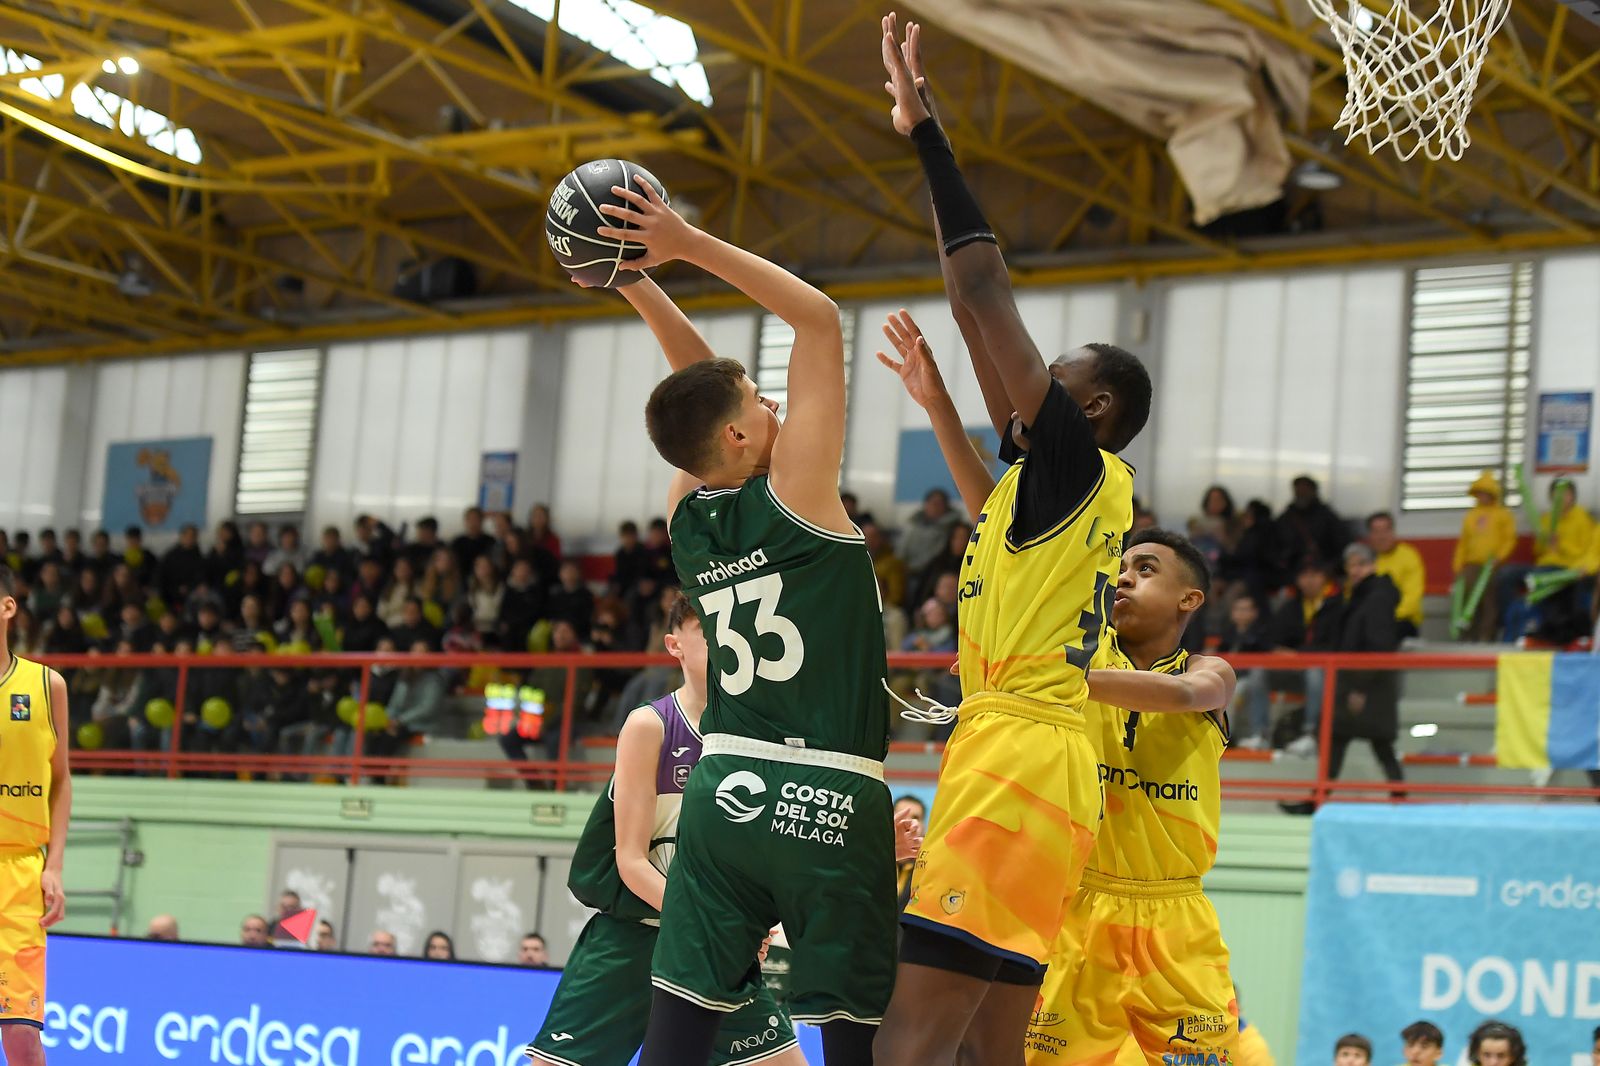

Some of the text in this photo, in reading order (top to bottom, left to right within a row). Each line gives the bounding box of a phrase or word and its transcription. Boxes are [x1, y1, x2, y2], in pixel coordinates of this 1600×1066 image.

[546, 229, 572, 257] SPA
[698, 572, 805, 696] 33
[0, 782, 42, 799] naria
[780, 782, 855, 814] COSTA
[774, 800, 849, 831] DEL SOL
[770, 818, 845, 847] MÁLAGA
[1500, 873, 1600, 910] ende
[40, 1000, 128, 1055] esa
[154, 1002, 361, 1066] endesa
[1187, 1014, 1225, 1025] BASKET
[1187, 1024, 1229, 1035] COUNTRY
[1024, 1028, 1067, 1047] derrama
[1033, 1041, 1060, 1056] DENTAL
[1162, 1052, 1221, 1066] SUMA
